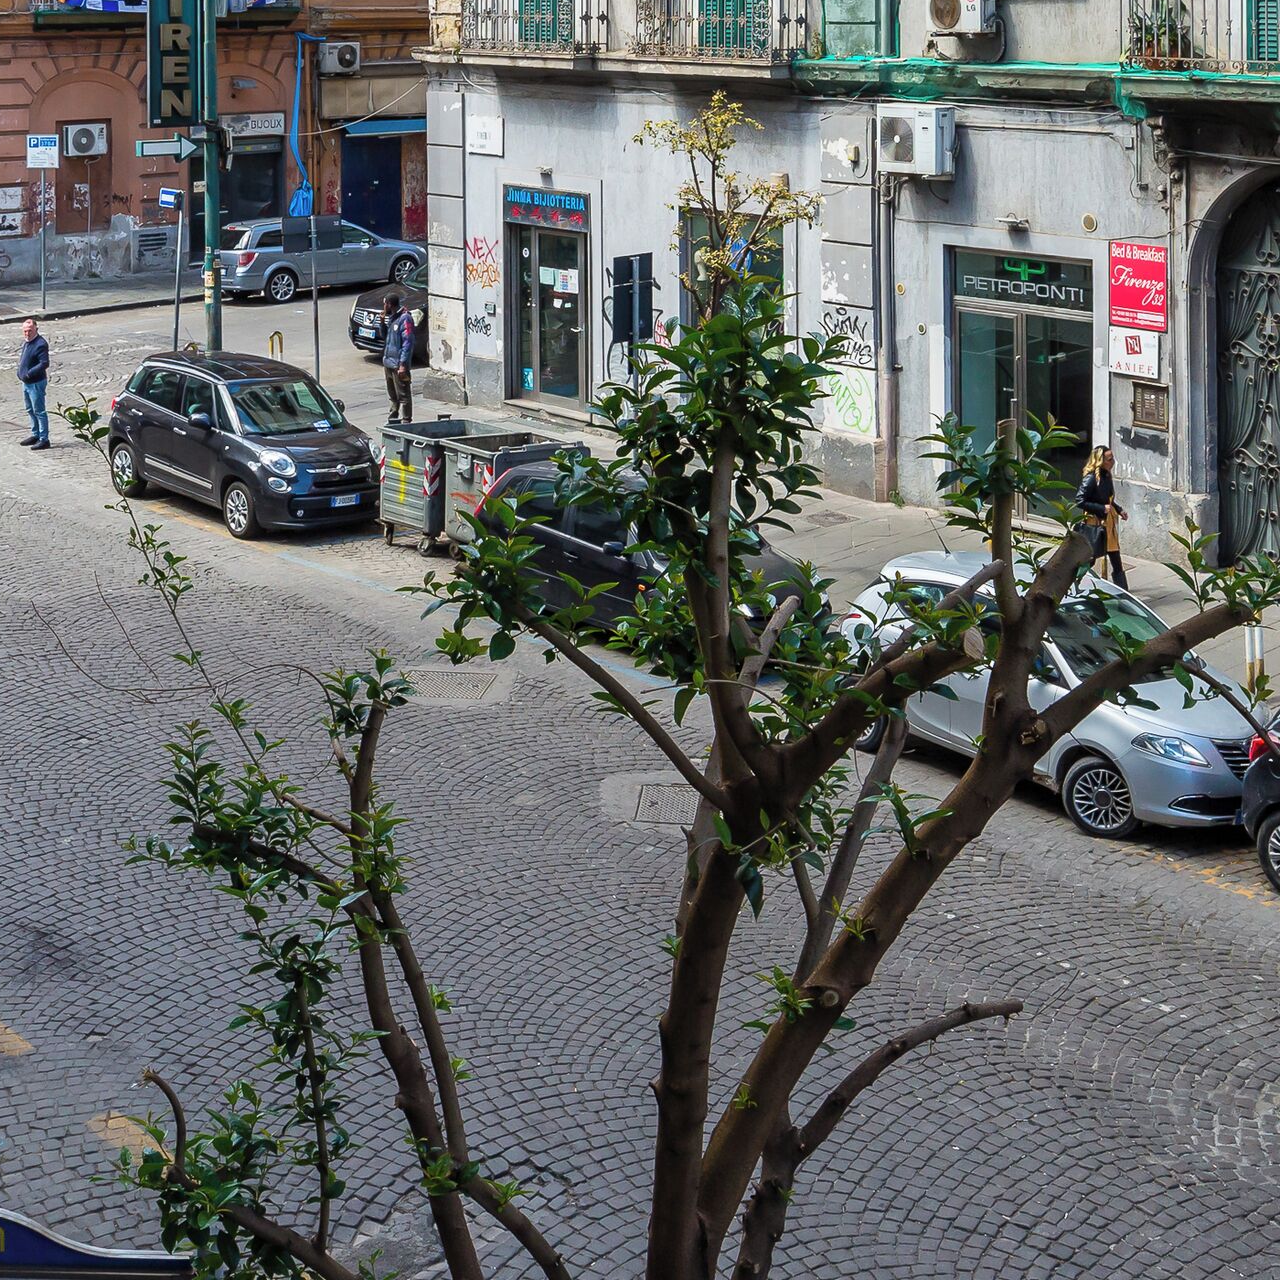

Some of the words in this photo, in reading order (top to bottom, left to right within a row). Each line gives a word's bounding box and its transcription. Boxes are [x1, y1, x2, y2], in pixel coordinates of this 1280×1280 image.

[966, 4, 976, 12] LG
[506, 187, 532, 205] JINMA
[533, 192, 586, 212] BIJIOTTERIA
[1111, 243, 1125, 258] Bed
[1126, 245, 1132, 259] &
[1132, 246, 1166, 263] Breakfast
[963, 275, 1084, 303] PIETROPONTI
[1111, 264, 1165, 306] Firenze
[1151, 294, 1164, 306] 32
